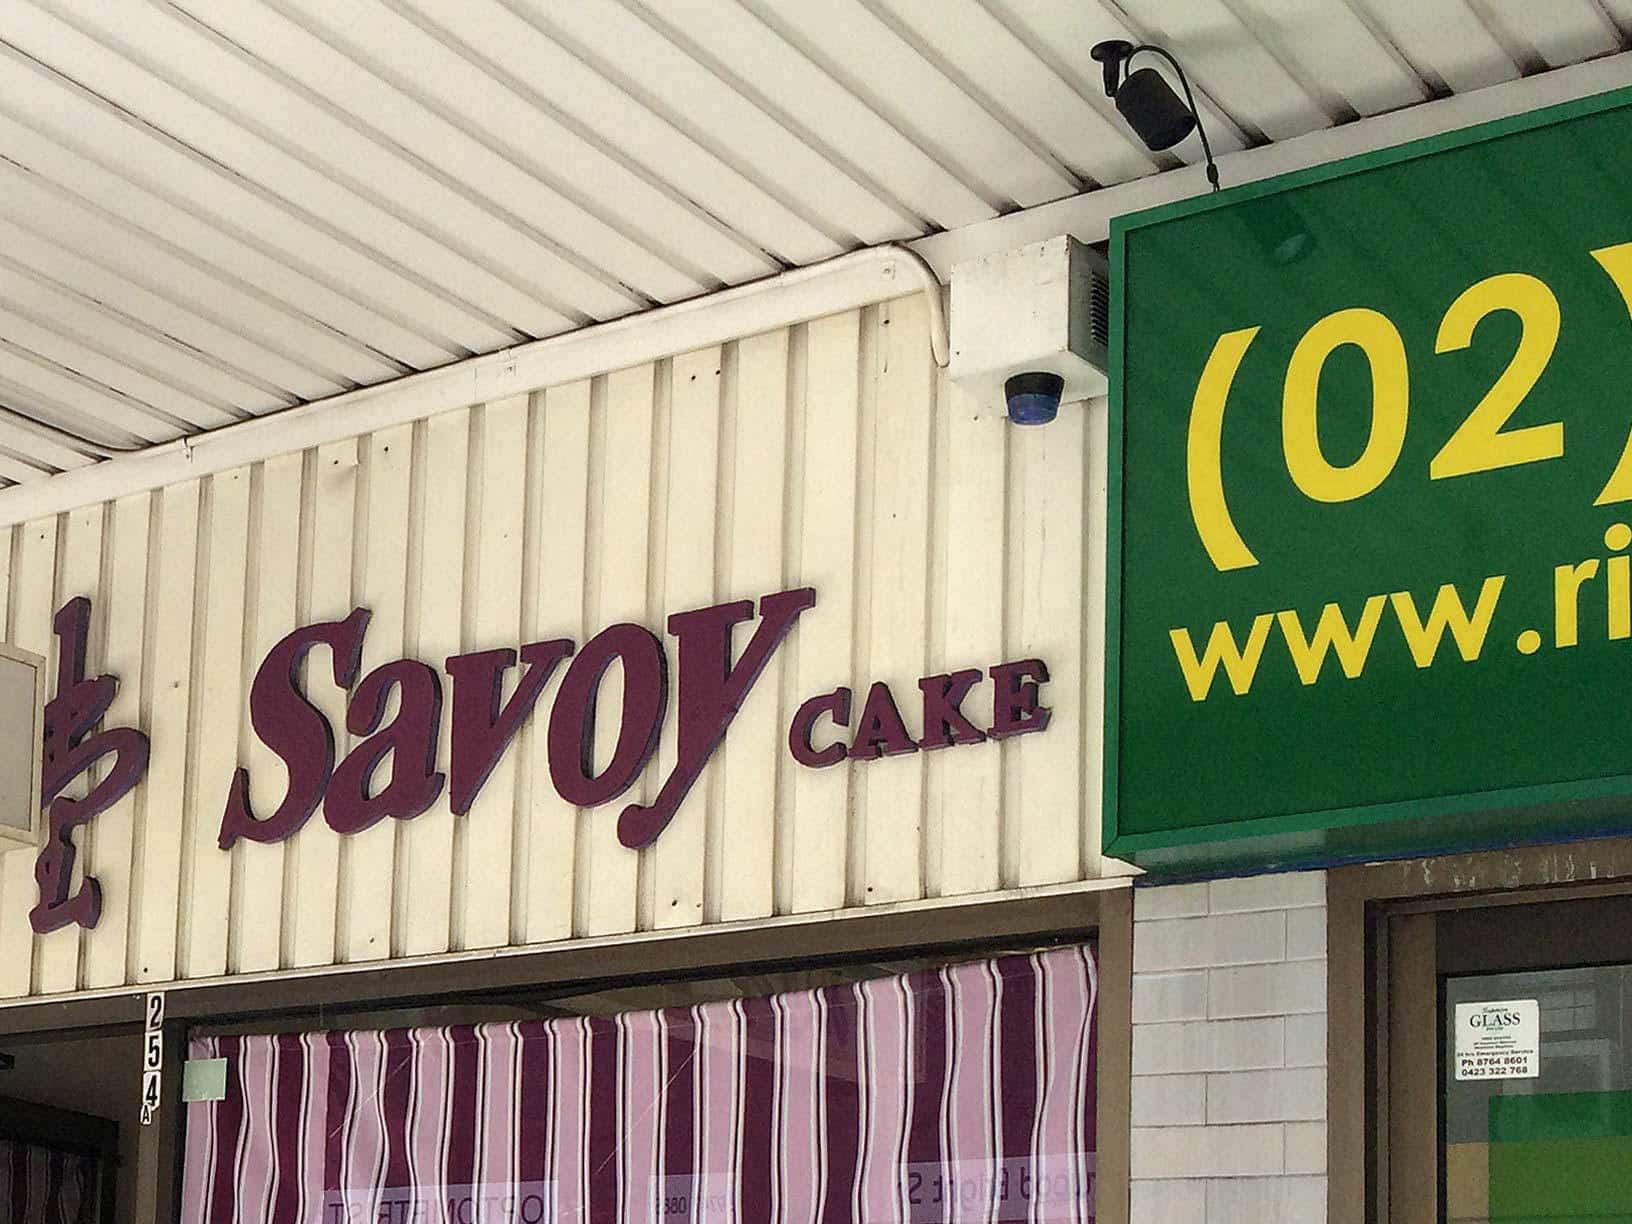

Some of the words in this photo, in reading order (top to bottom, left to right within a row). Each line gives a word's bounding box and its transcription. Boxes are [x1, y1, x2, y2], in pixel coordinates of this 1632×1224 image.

[218, 587, 816, 850] Savoy
[789, 658, 1052, 768] CAKE
[1470, 1012, 1520, 1028] GLASS
